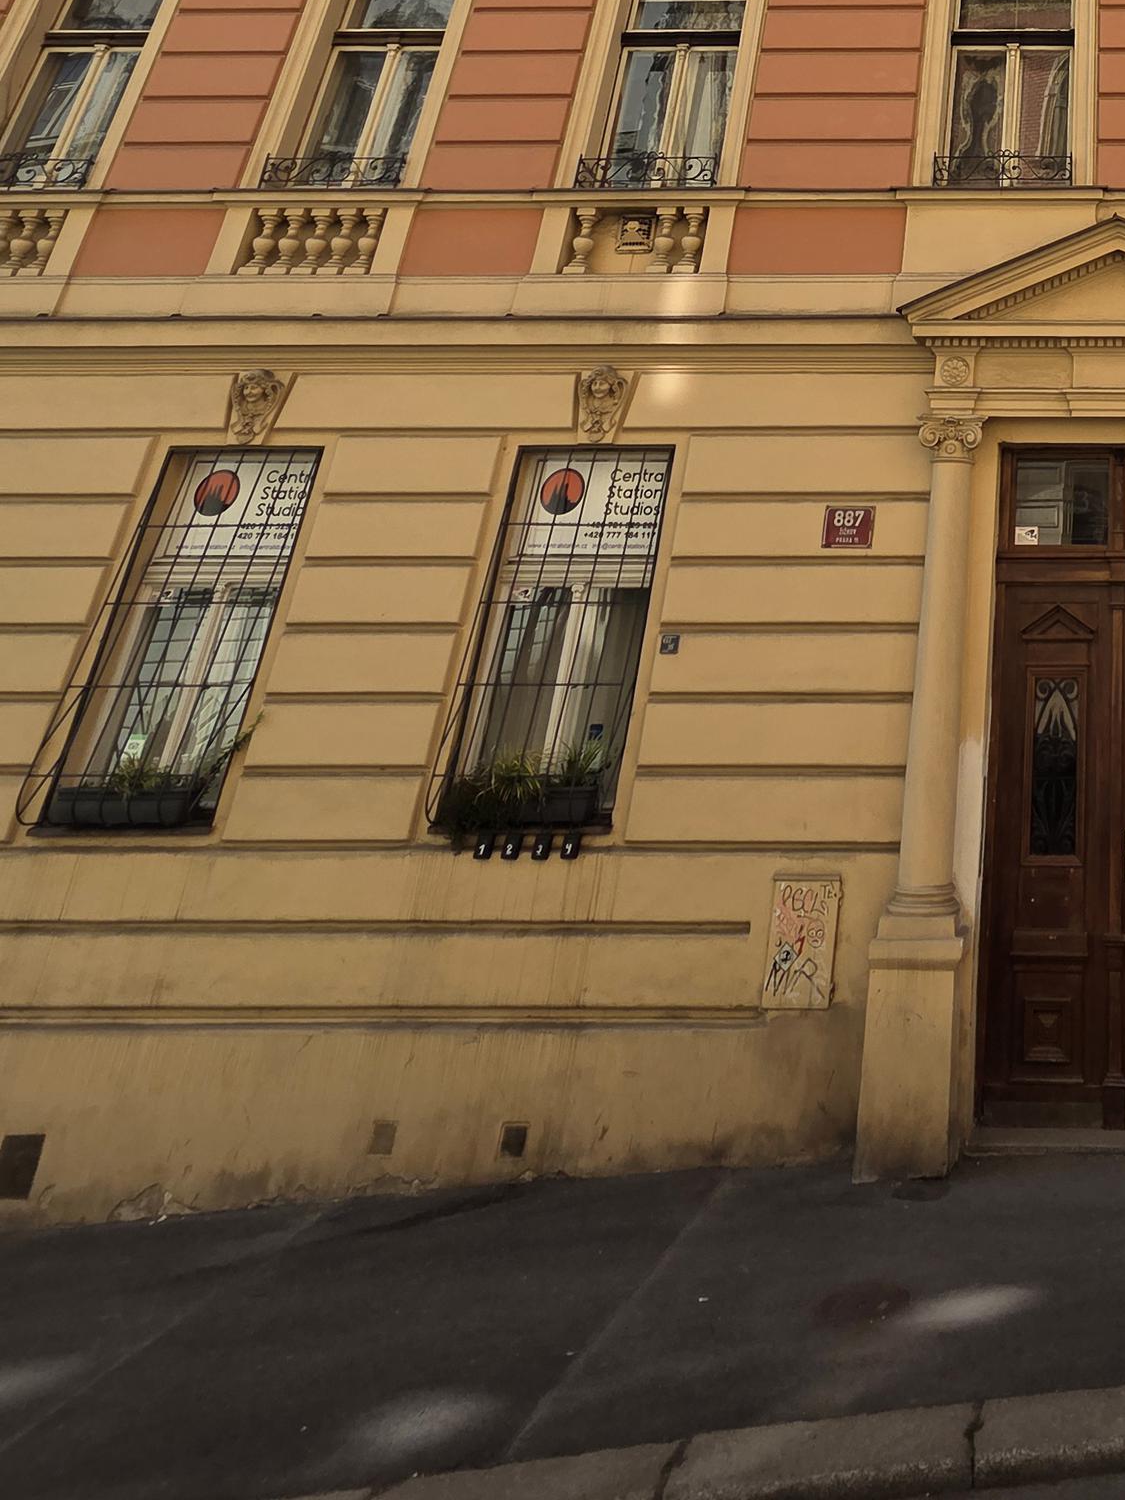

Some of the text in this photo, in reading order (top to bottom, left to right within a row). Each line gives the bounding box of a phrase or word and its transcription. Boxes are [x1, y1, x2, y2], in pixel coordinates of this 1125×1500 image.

[266, 469, 310, 484] Centr
[610, 468, 665, 483] Centra
[260, 486, 307, 500] Statio
[607, 485, 662, 499] Station
[255, 502, 304, 517] Studio
[604, 502, 660, 516] Studios
[833, 510, 865, 527] 887
[479, 844, 486, 855] 1
[506, 843, 514, 856] 2
